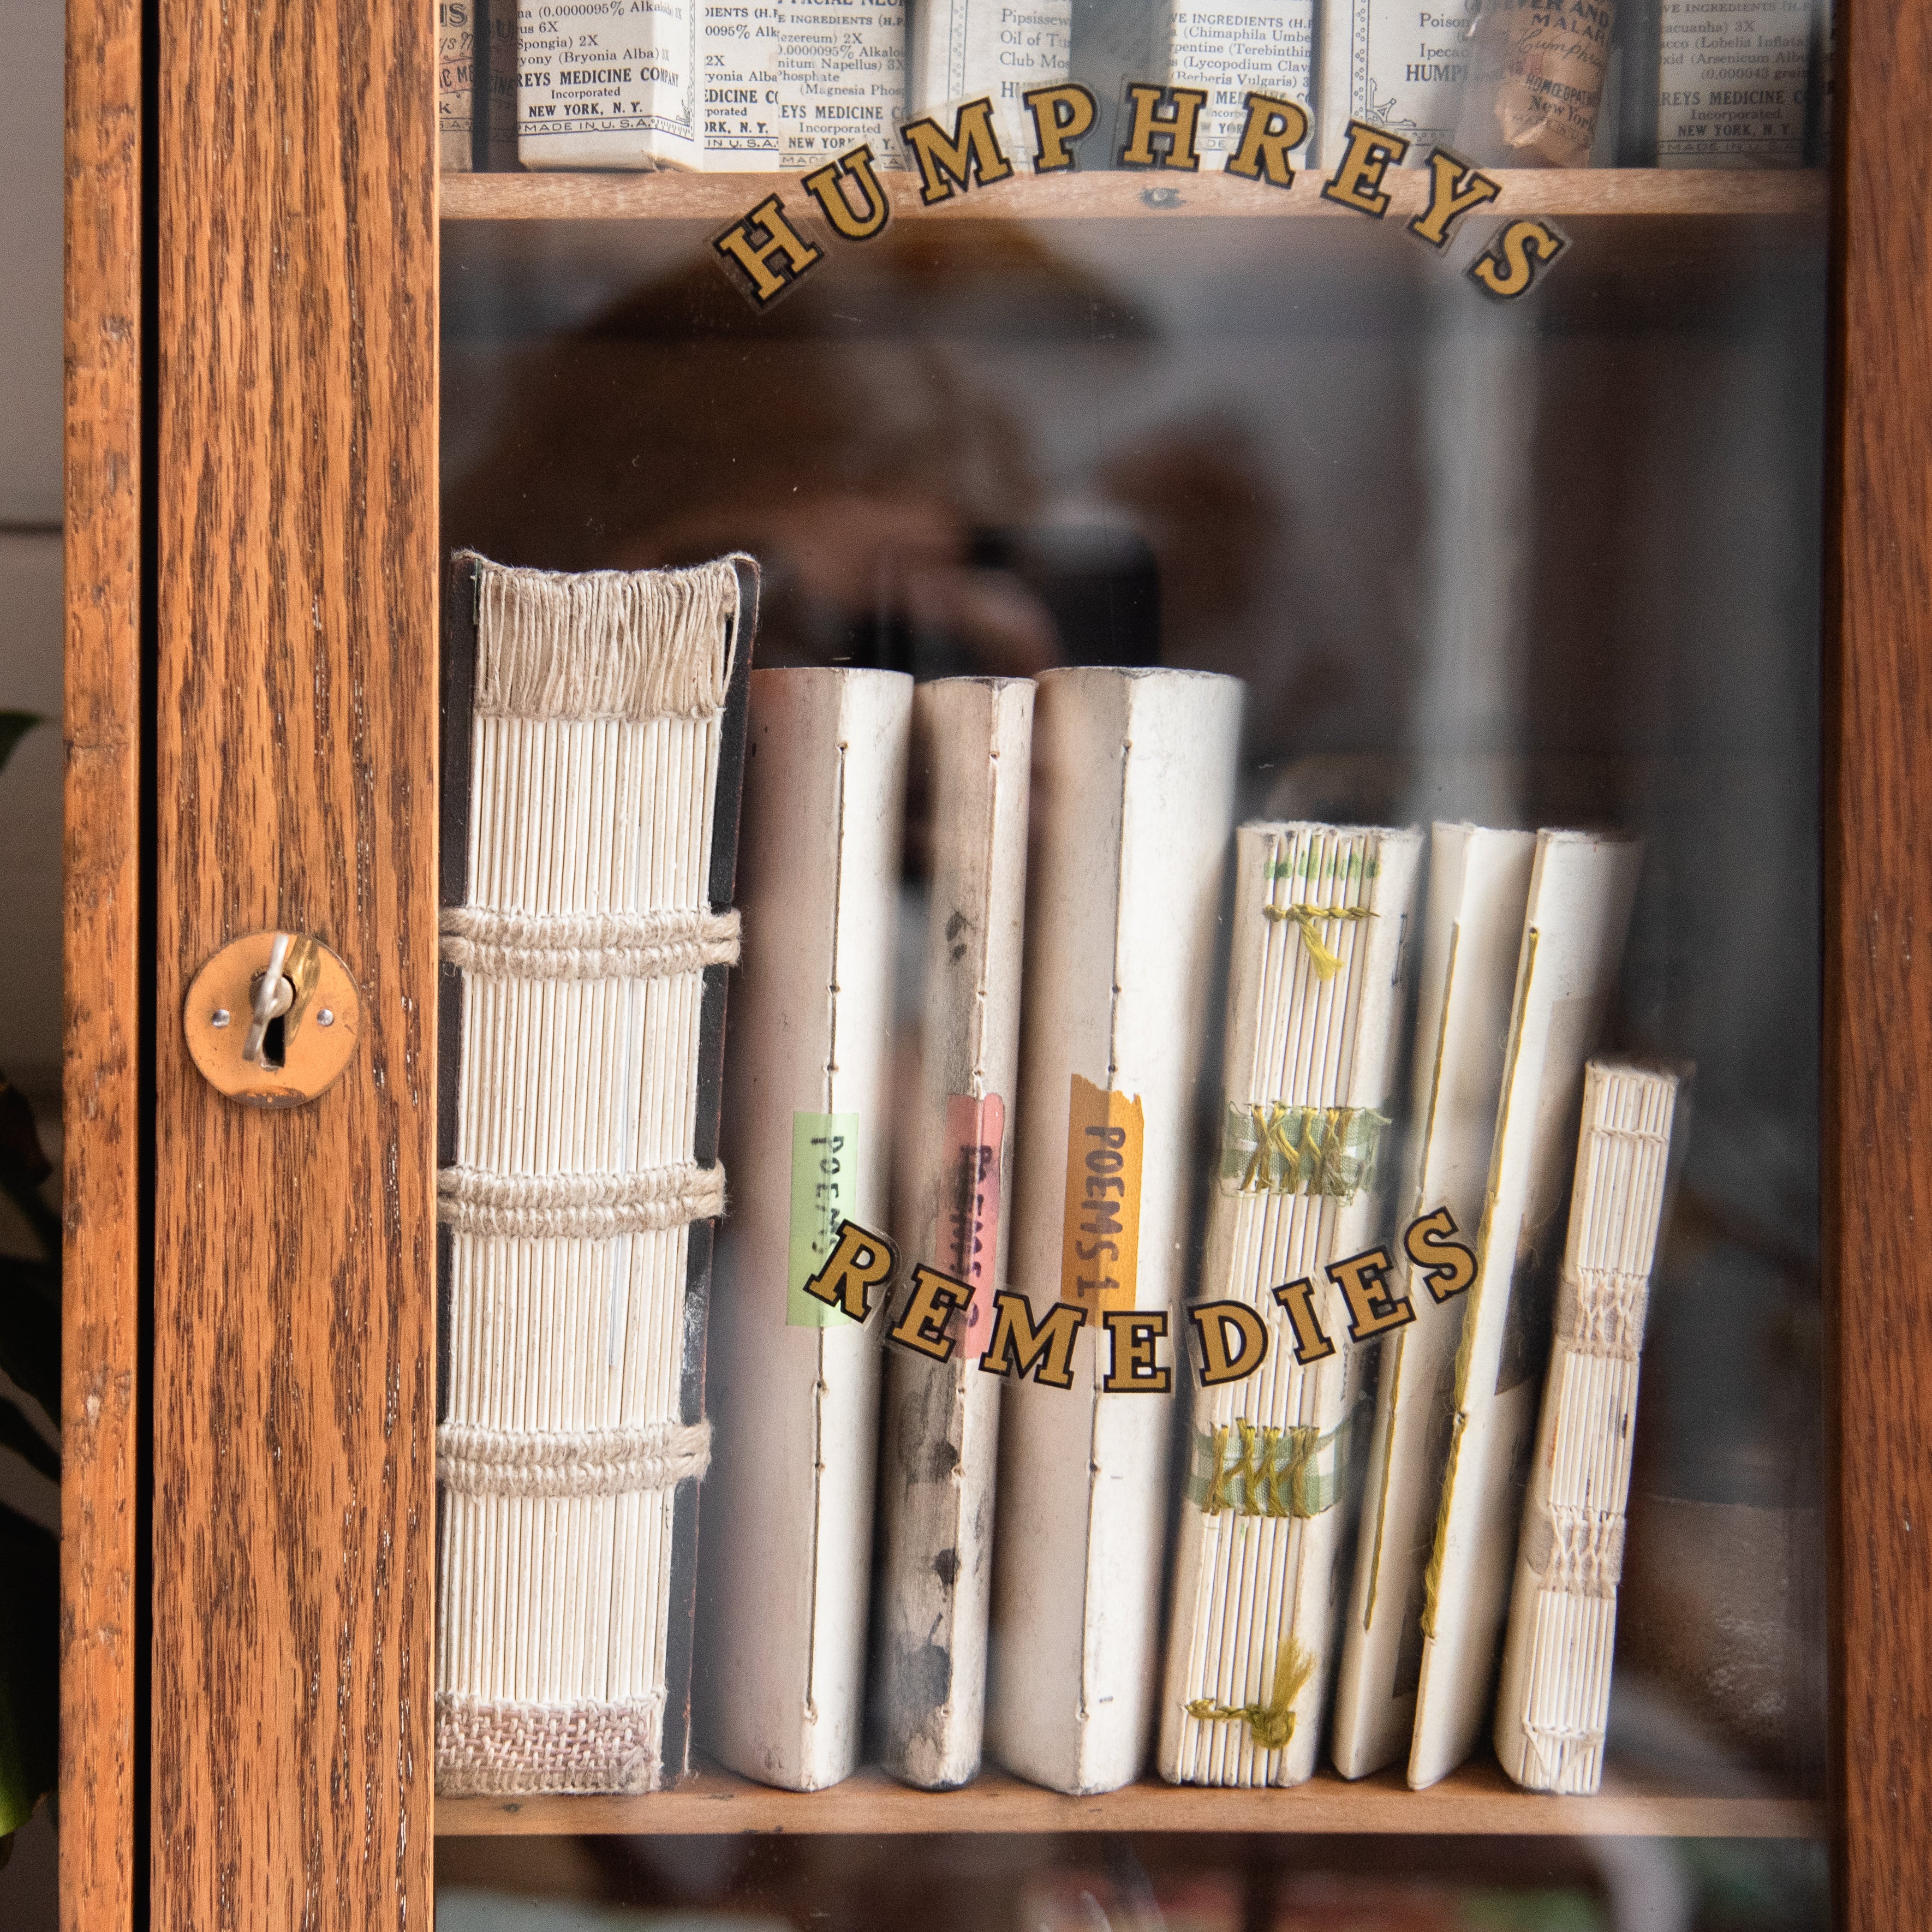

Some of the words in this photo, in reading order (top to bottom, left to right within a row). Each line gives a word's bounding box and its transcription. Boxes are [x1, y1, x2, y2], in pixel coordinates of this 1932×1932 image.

[539, 22, 559, 33] 6X
[791, 15, 873, 26] INGREDIENTS
[1192, 13, 1284, 28] INGREDIENTS
[579, 34, 599, 47] 2X
[843, 33, 863, 44] 2X
[1000, 30, 1022, 45] Oil
[1027, 32, 1041, 46] of
[1183, 26, 1266, 43] (Chimaphila
[558, 49, 617, 65] (Bryonia
[623, 48, 659, 61] Alba)
[706, 55, 725, 66] 2X
[1000, 52, 1035, 67] Club
[821, 58, 882, 73] Napellus)
[1183, 56, 1272, 73] (Lycopodium
[559, 68, 631, 85] MEDICINE
[640, 67, 679, 88] COMPANY
[1237, 73, 1297, 88] Vulgaris)
[551, 86, 621, 99] Incorporated
[800, 83, 866, 97] (Magnesia
[1709, 91, 1784, 105] MEDICINE
[528, 104, 557, 117] NEW
[564, 103, 604, 116] YORK,
[613, 102, 625, 114] N.
[630, 102, 643, 113] Y.
[815, 105, 884, 120] MEDICINE
[1690, 108, 1781, 121] Incorporated
[524, 121, 573, 133] MADE
[580, 120, 595, 129] IN
[740, 122, 752, 133] N.
[757, 122, 768, 133] Y.
[799, 122, 881, 135] Incorporated
[1678, 125, 1707, 138] NEW
[707, 139, 723, 147] IN
[788, 136, 815, 148] NEW
[712, 82, 1566, 303] HUMPHREYS
[1075, 1125, 1126, 1262] POEMS
[1076, 1275, 1120, 1298] 1
[803, 1206, 1478, 1393] REMEDIES
